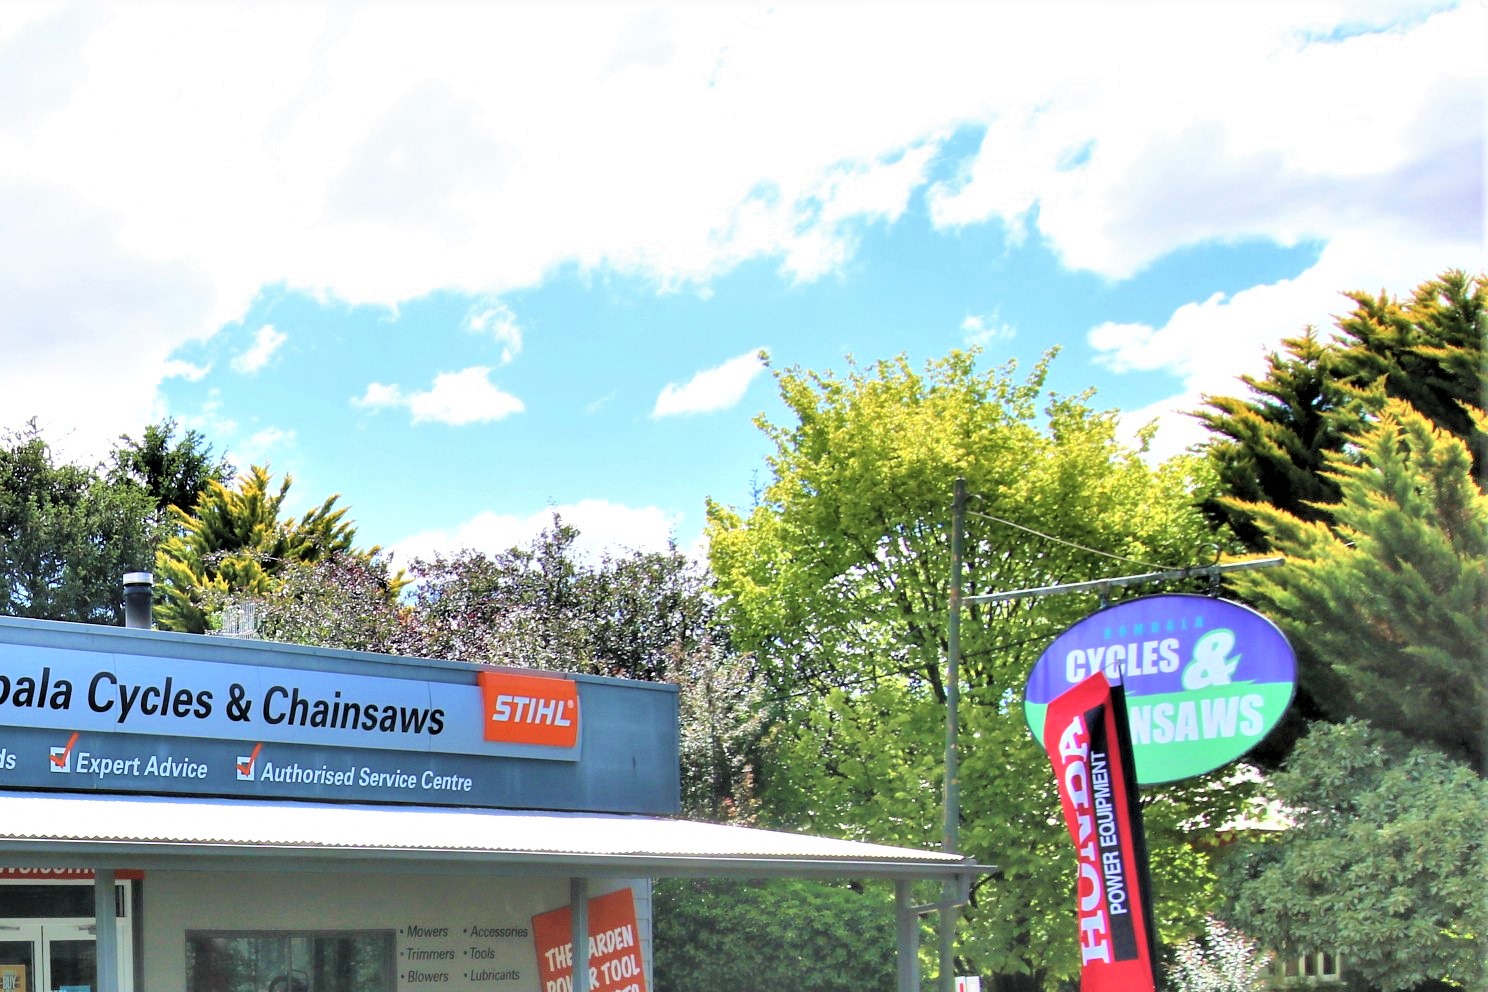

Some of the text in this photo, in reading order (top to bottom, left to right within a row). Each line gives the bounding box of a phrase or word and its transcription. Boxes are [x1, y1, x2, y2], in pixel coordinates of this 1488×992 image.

[1103, 616, 1205, 639] BOMBALA
[1066, 628, 1241, 691] CYCLES &
[87, 671, 214, 724] Cycles
[226, 683, 252, 722] &
[262, 685, 445, 735] Chainsaws
[492, 695, 571, 727] STIHL
[1132, 694, 1263, 746] NSAWS
[76, 752, 208, 779] Expert Advice
[260, 762, 473, 792] Authorised Service Centre
[1059, 715, 1110, 967] HONDA
[1090, 750, 1128, 915] POWER EQUIPMENT
[407, 925, 448, 938] Mowers
[470, 925, 528, 938] Accessories
[406, 948, 455, 960] Trimmers
[470, 947, 496, 960] Tools
[545, 924, 634, 972] THE ARDEN
[407, 970, 449, 983] Blowers
[470, 969, 520, 982] Lubricants
[600, 954, 640, 985] TOOL
